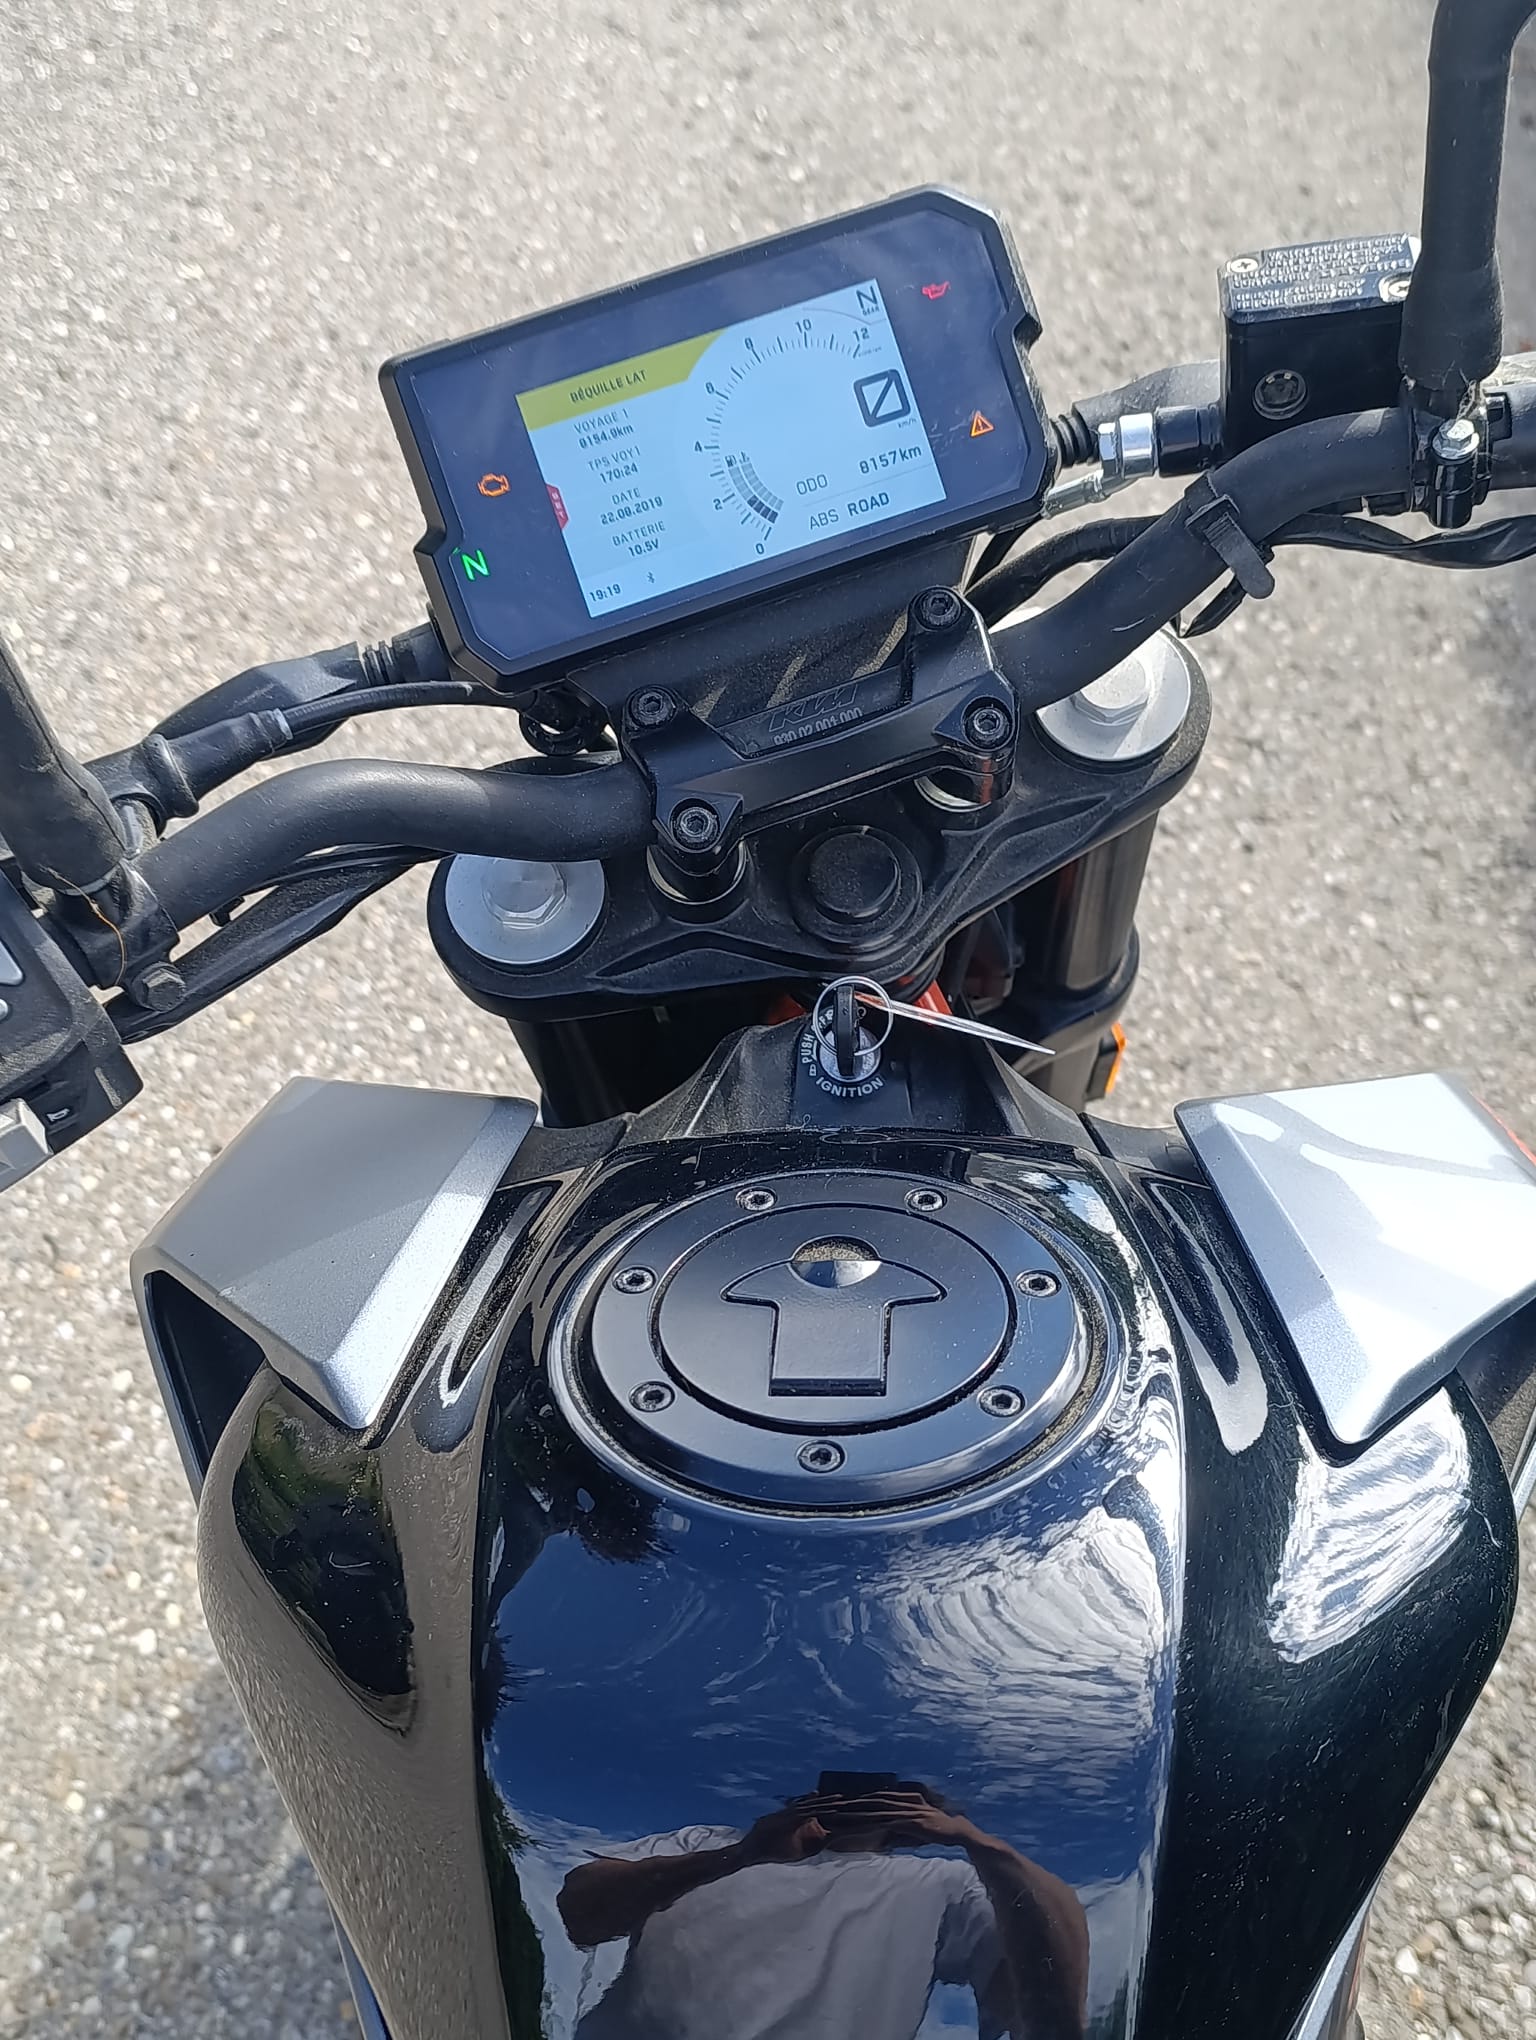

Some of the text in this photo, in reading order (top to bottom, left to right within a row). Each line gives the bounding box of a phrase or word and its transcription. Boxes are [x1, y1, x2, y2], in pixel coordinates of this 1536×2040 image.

[856, 285, 878, 309] N
[795, 318, 812, 333] 10
[853, 327, 870, 342] 12
[625, 369, 647, 385] LAT
[694, 441, 703, 453] 4
[600, 463, 639, 484] 170:24
[796, 473, 828, 495] ODO
[612, 487, 641, 505] DATE
[713, 498, 723, 511] 2
[809, 492, 890, 530] ABS ROAD
[612, 520, 666, 546] BATTERIE
[628, 538, 659, 557] 10.5V
[755, 543, 765, 555] 0
[462, 549, 490, 581] N
[589, 584, 621, 601] 19:19
[801, 1033, 815, 1064] PUSH
[815, 1077, 884, 1097] IGNITION
